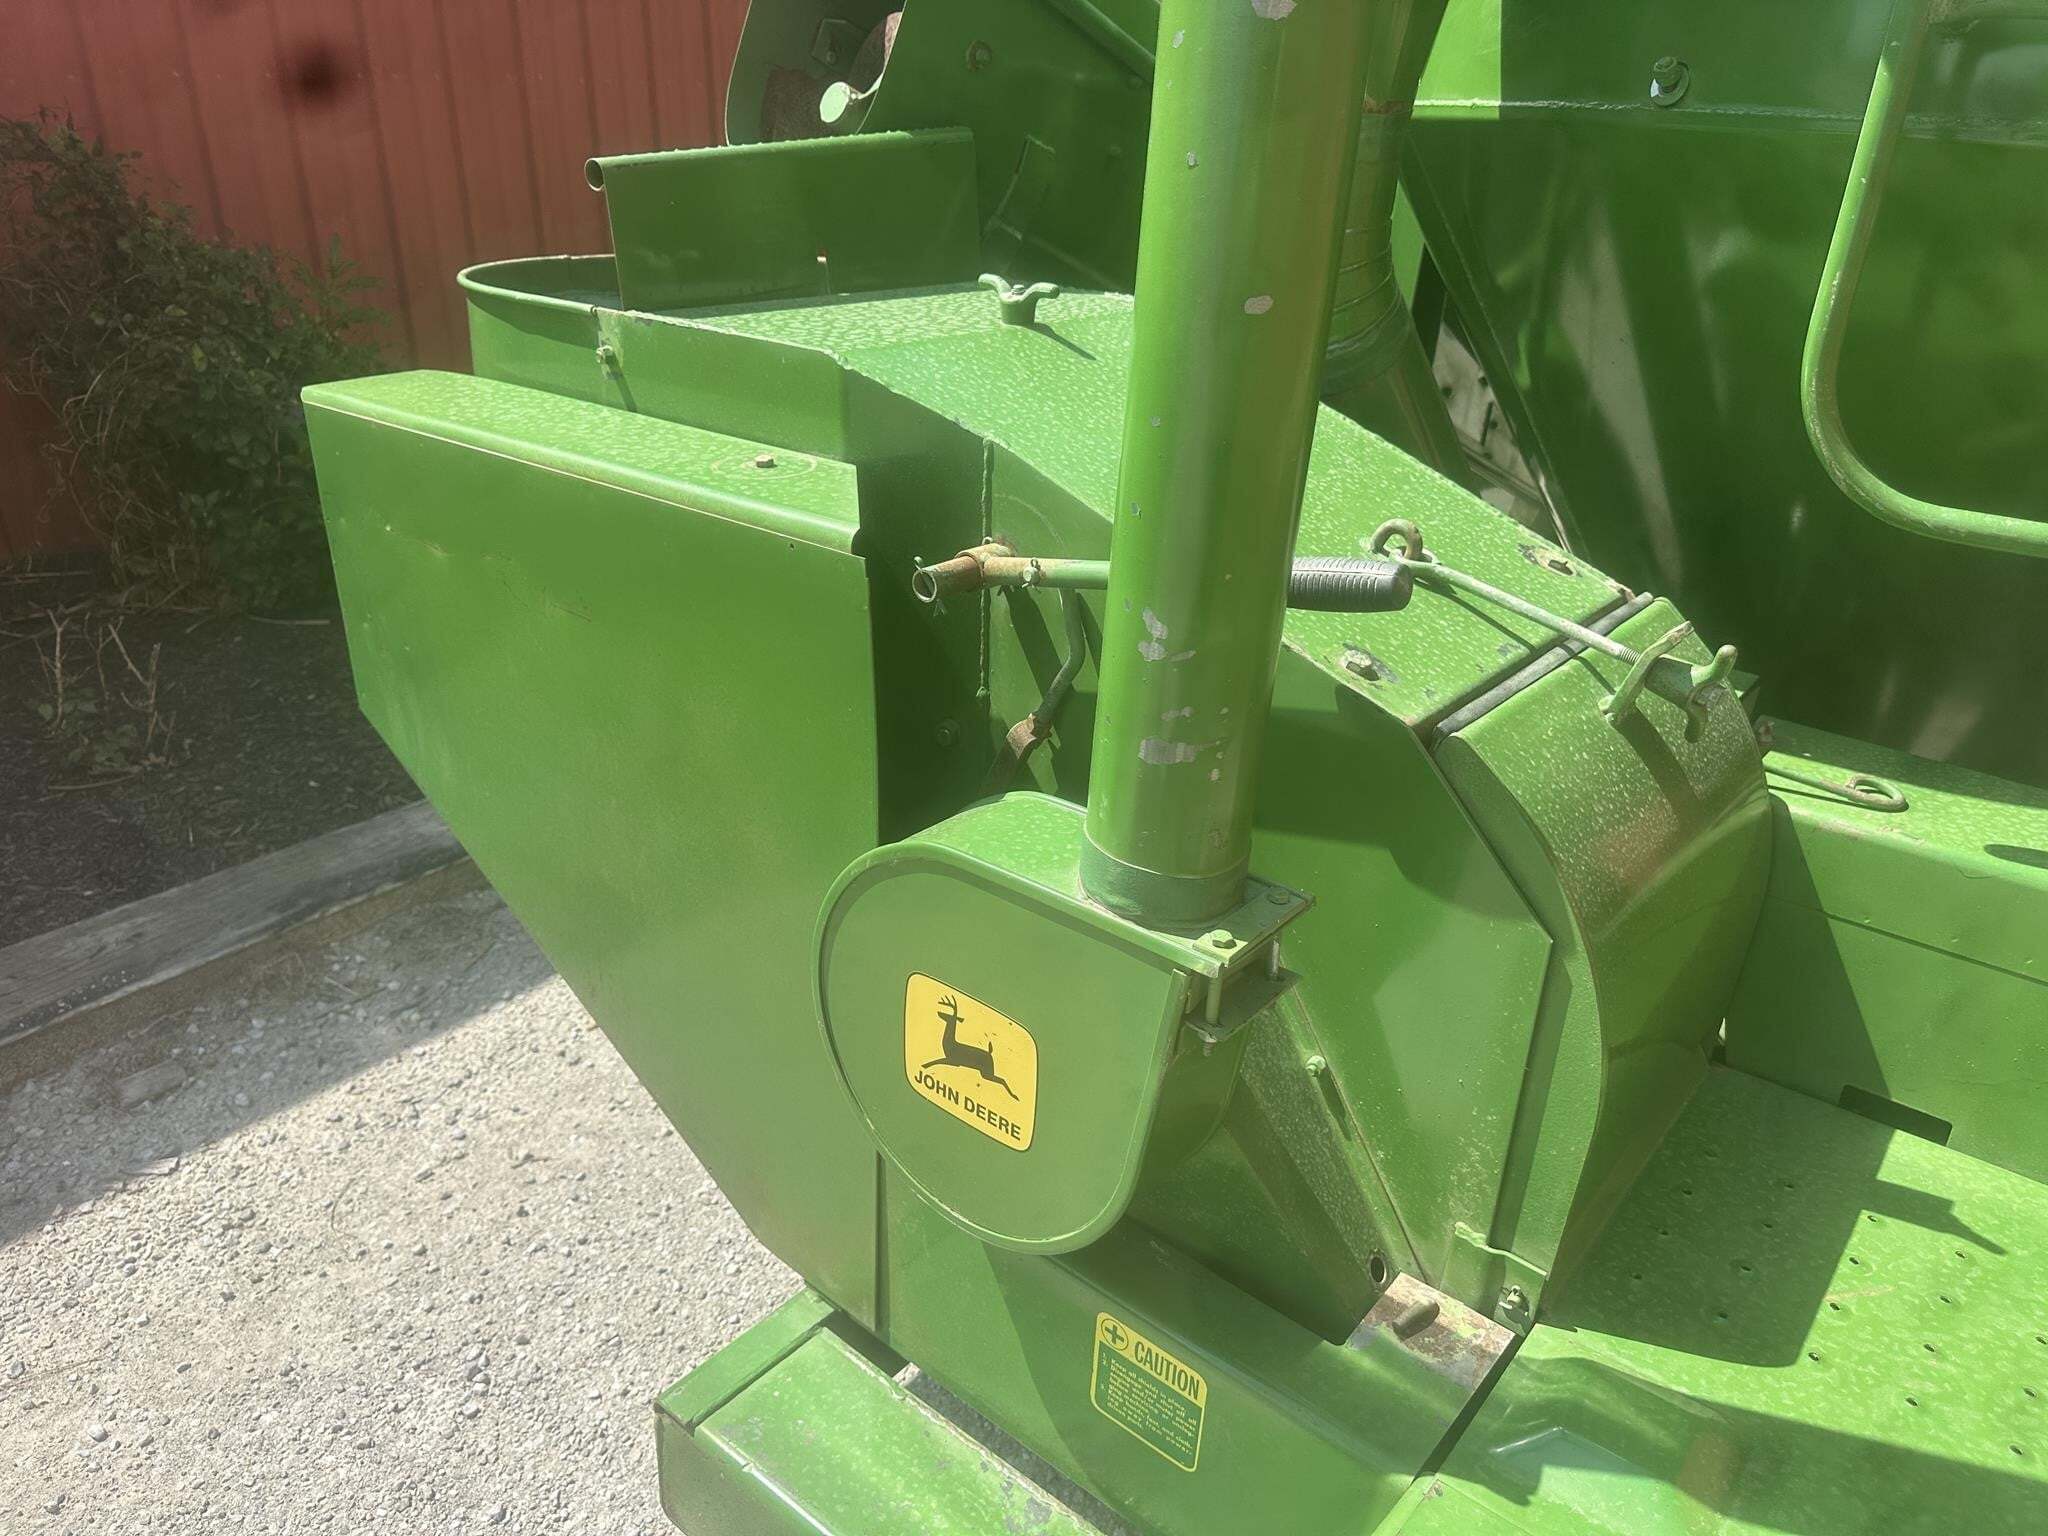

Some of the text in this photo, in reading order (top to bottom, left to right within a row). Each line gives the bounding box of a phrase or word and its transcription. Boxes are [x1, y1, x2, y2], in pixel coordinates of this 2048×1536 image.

[914, 1070, 1021, 1141] JOHN DEERE
[1134, 1341, 1200, 1401] CAUTION
